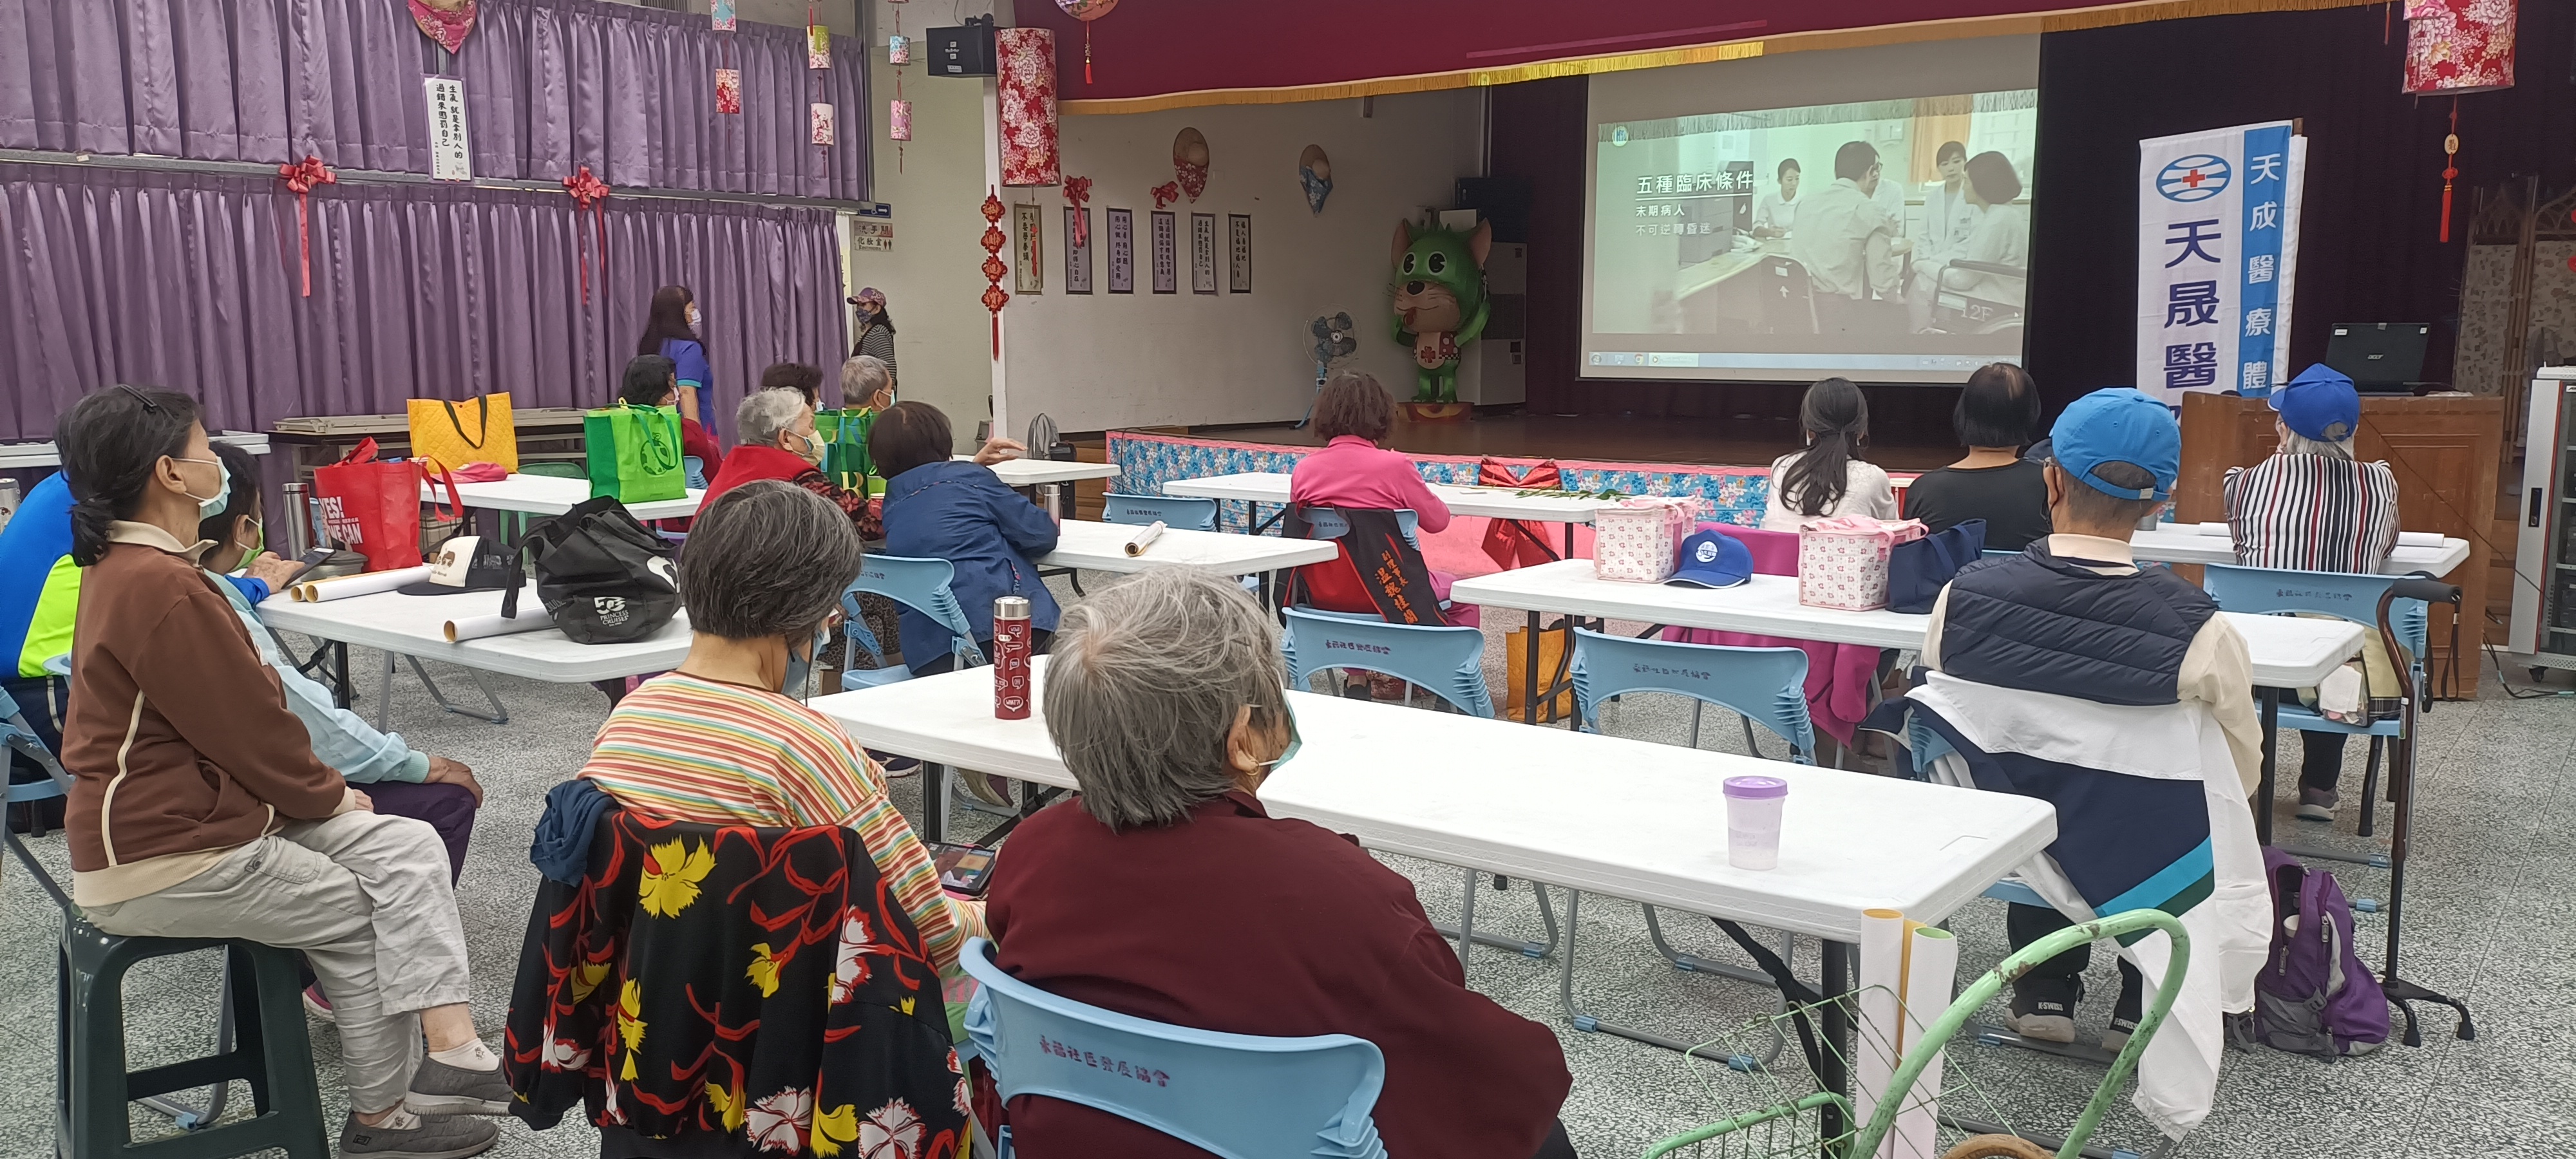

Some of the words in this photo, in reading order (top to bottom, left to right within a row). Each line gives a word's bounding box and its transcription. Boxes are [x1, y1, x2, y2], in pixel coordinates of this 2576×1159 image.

[1636, 170, 1754, 194] 五種臨床條件
[1636, 203, 1685, 218] 末期病人
[319, 496, 345, 519] YES!
[341, 523, 363, 545] CAN
[600, 610, 629, 621] PRINCESS
[602, 615, 629, 625] CRUISES
[2038, 1001, 2063, 1011] K-SWISS
